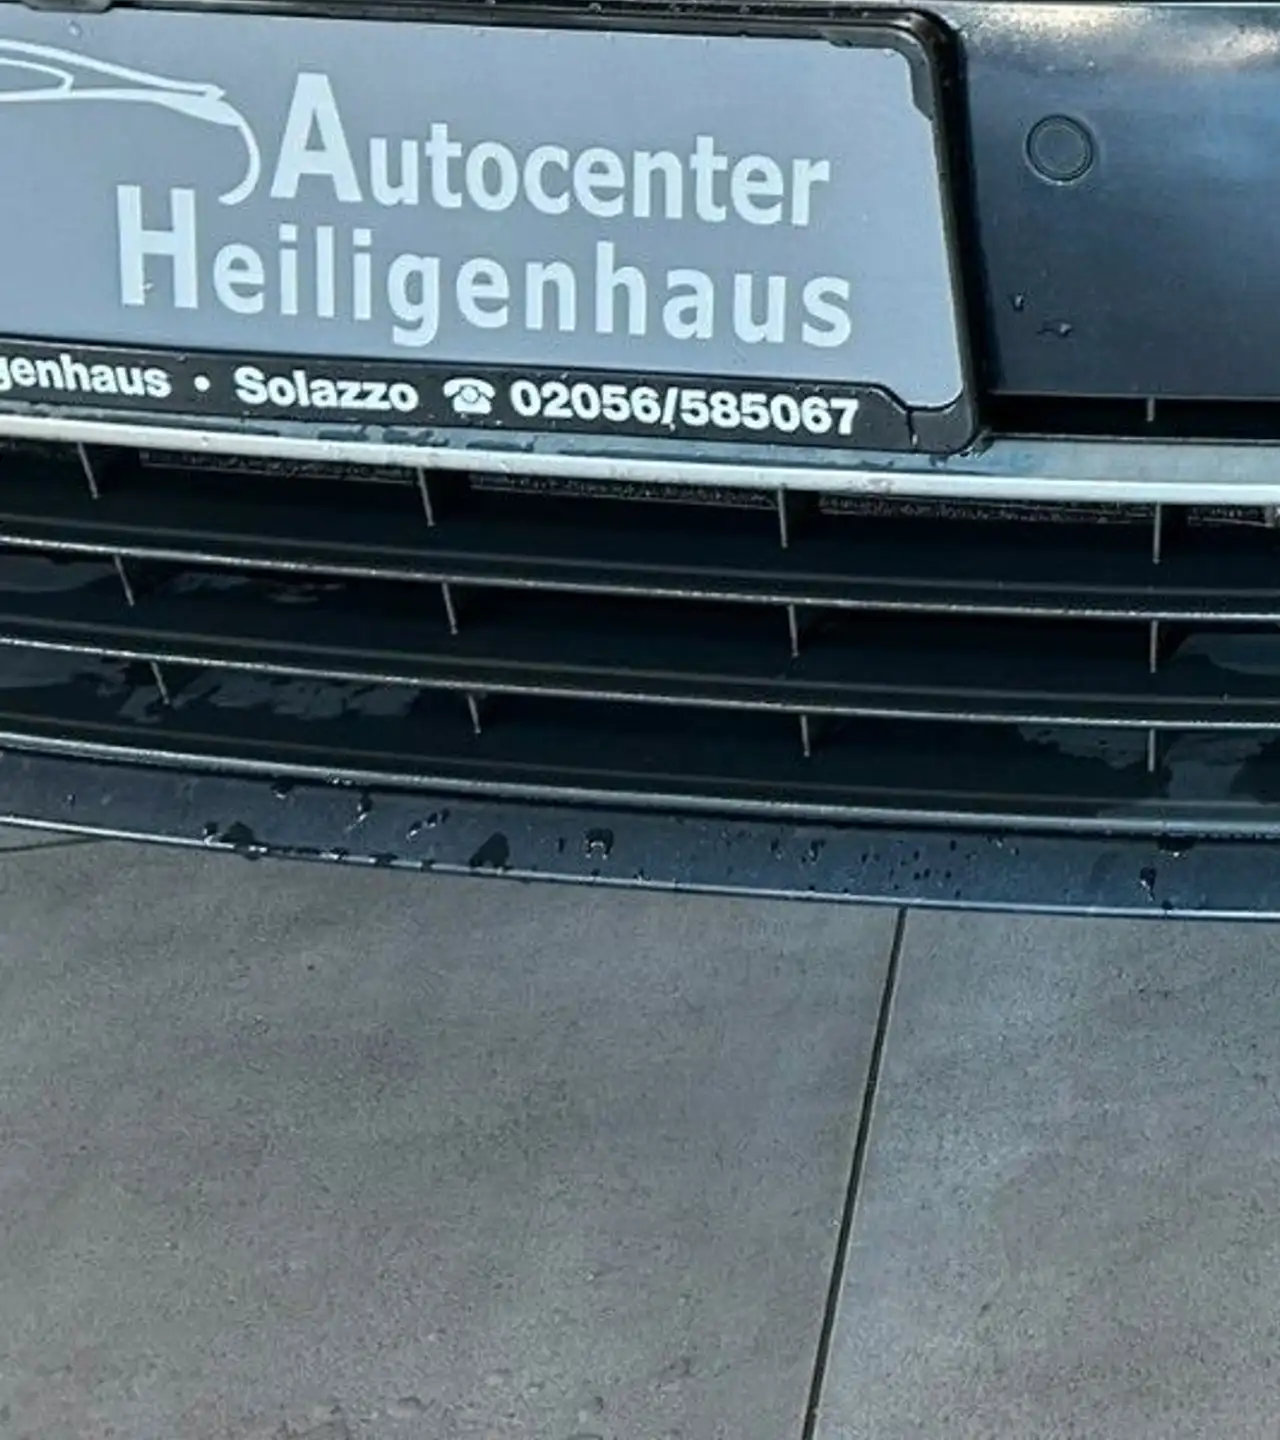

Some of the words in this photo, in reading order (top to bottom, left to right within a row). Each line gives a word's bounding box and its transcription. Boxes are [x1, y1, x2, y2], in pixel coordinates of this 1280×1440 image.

[270, 72, 831, 226] Autocenter
[117, 184, 852, 348] Heiligenhaus
[235, 366, 419, 412] Solazzo
[510, 380, 859, 435] 02056/585067
